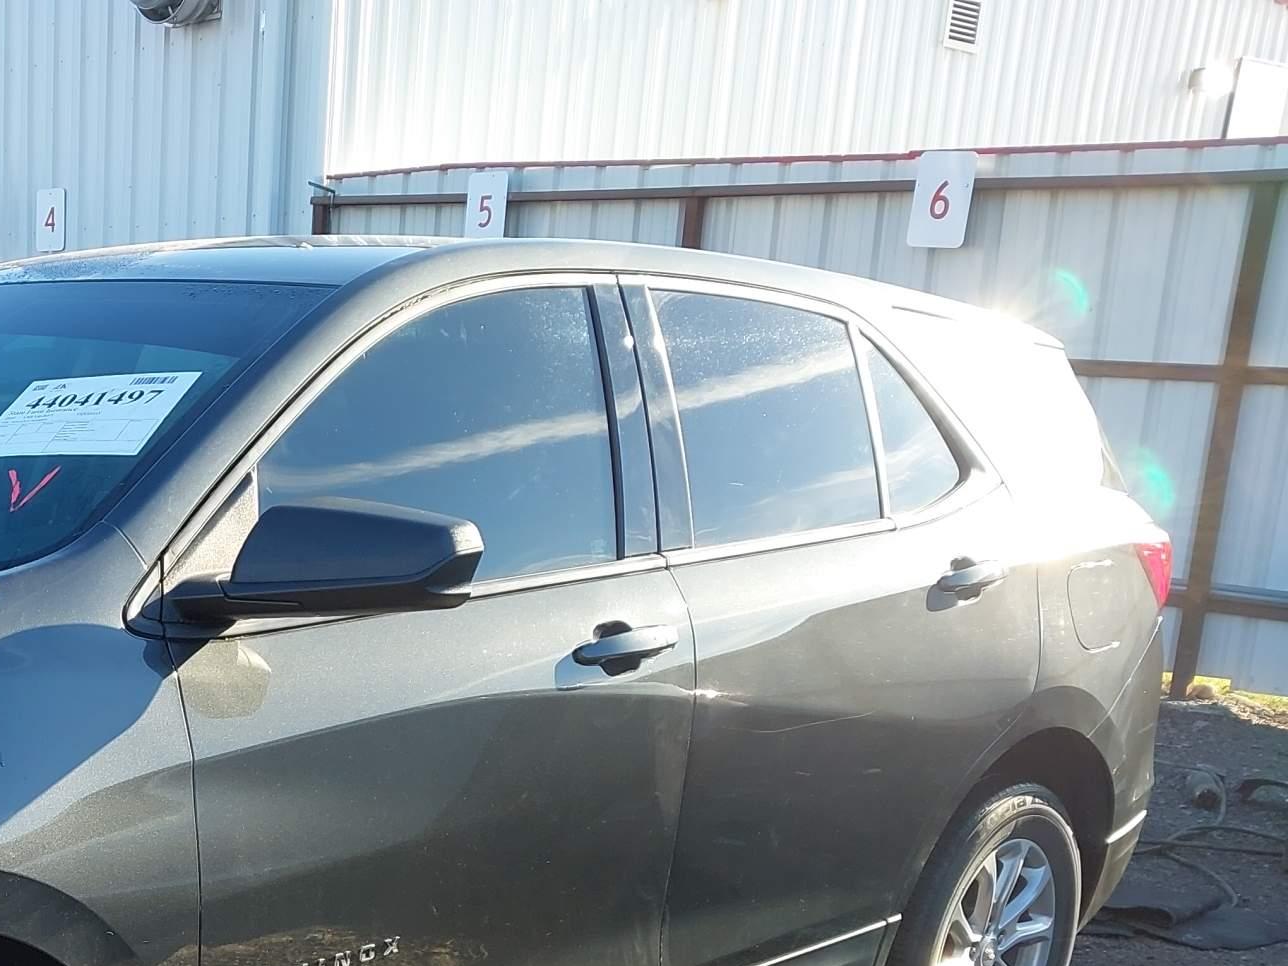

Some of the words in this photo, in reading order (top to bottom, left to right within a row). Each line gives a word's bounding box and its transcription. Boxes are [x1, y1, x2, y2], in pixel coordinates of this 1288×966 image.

[478, 194, 493, 228] 5
[929, 180, 950, 220] 6
[44, 206, 56, 233] 4
[26, 389, 166, 410] 44041497
